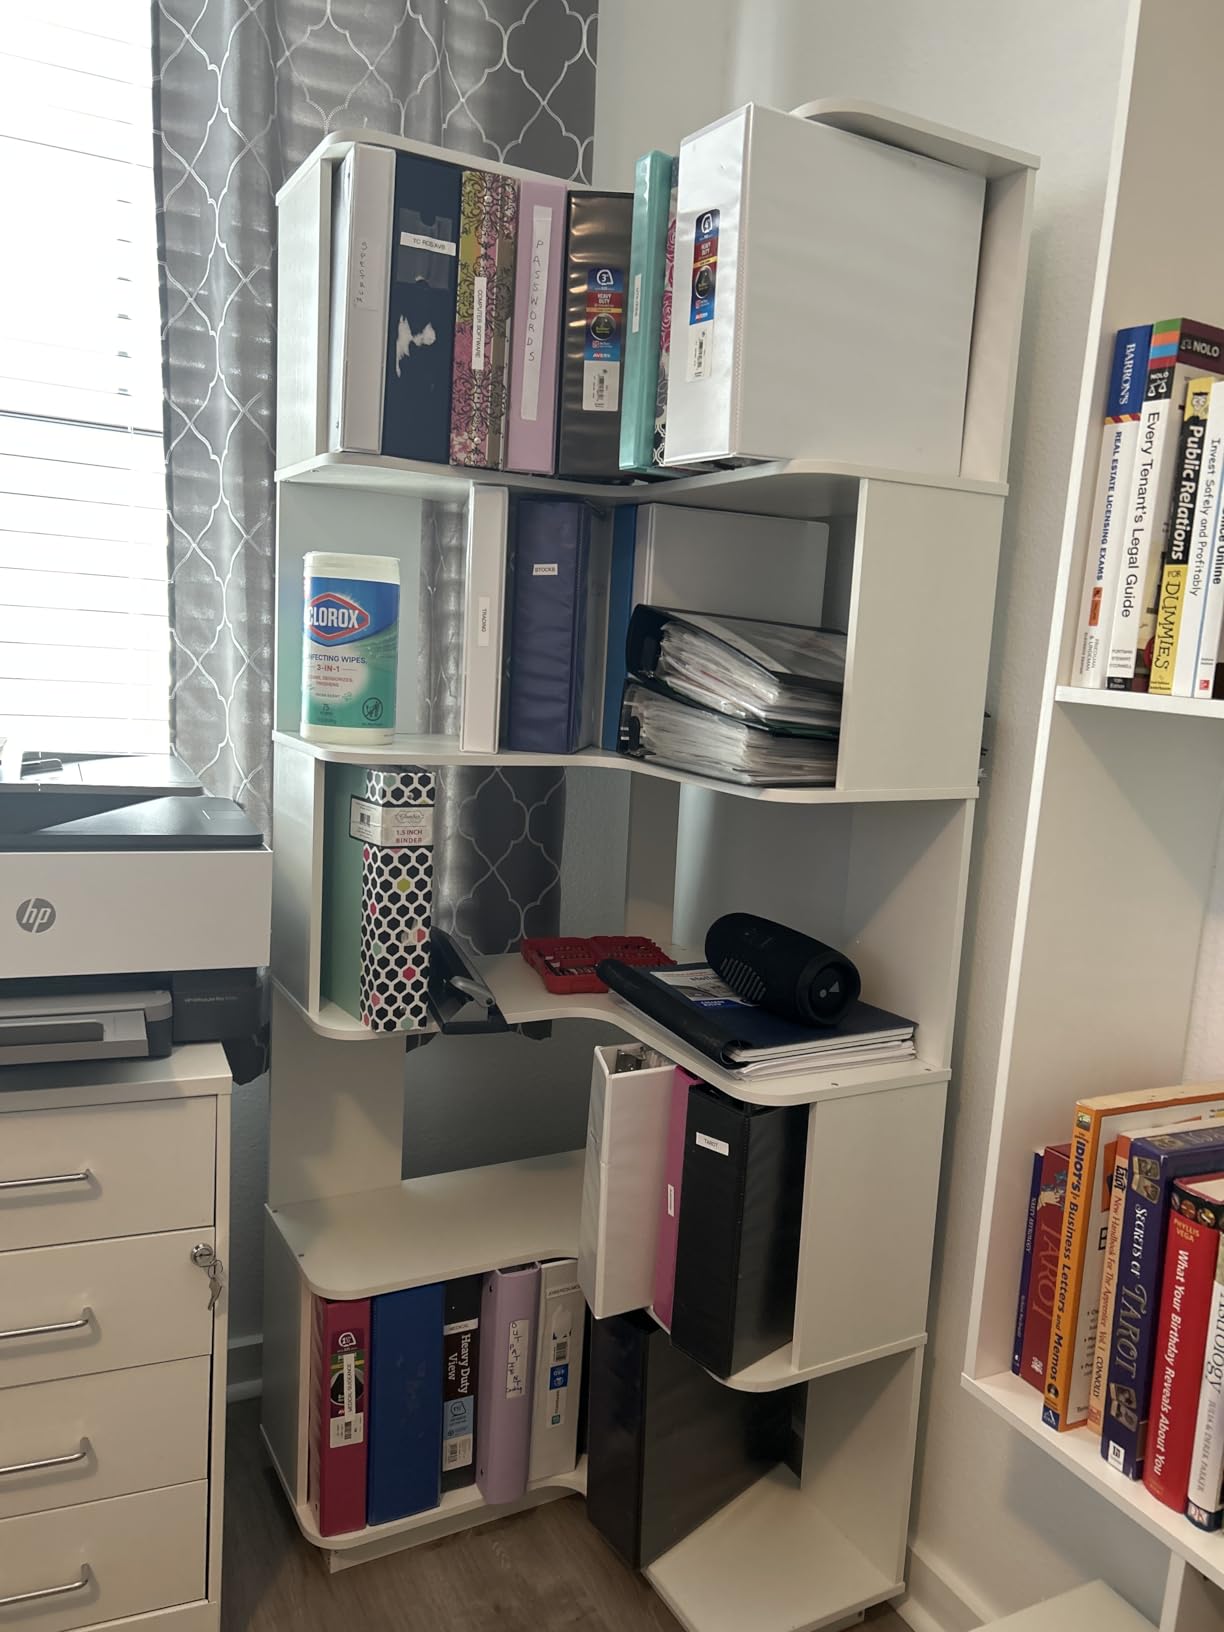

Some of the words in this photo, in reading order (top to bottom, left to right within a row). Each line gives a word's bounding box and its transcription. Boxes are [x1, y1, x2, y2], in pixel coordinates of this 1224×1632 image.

[526, 240, 544, 362] PASSWORDS
[474, 324, 482, 359] SOFTWARE
[1192, 341, 1220, 357] NOLO
[1119, 343, 1136, 405] BARRON'S
[1150, 371, 1170, 380] NOLO
[1112, 431, 1122, 456] REAL
[1141, 412, 1160, 455] Every
[1182, 425, 1203, 479] Public
[1207, 438, 1221, 474] Invest
[1108, 459, 1118, 492] ESTATE
[1134, 459, 1153, 524] Tenant's
[1200, 480, 1215, 515] Safely
[1101, 495, 1114, 545] LICENSING
[1171, 481, 1196, 560] Relations
[1199, 518, 1208, 538] and
[1096, 547, 1106, 581] EXAMS
[1127, 528, 1144, 569] Legal
[1189, 541, 1207, 597] Profitably
[1121, 574, 1138, 618] Guide
[307, 606, 360, 629] CLOROX
[1154, 581, 1181, 670] DUMMIES
[316, 664, 340, 673] 3-IN-1
[21, 898, 52, 933] hp
[1071, 1140, 1087, 1196] IDIOT'S
[1064, 1202, 1079, 1260] Business
[1173, 1217, 1200, 1237] PHYLLIS
[1176, 1228, 1195, 1242] VEGA
[1176, 1249, 1189, 1283] What
[1057, 1264, 1071, 1313] Letters
[1172, 1285, 1185, 1312] Your
[1116, 1284, 1148, 1379] TAROT
[1165, 1313, 1182, 1366] Birthday
[447, 1353, 458, 1380] View
[458, 1333, 471, 1369] Heavy
[1050, 1333, 1064, 1382] Memos
[458, 1369, 471, 1394] Duty
[1160, 1366, 1175, 1413] Reveals
[1156, 1413, 1170, 1452] About
[1153, 1453, 1165, 1476] You
